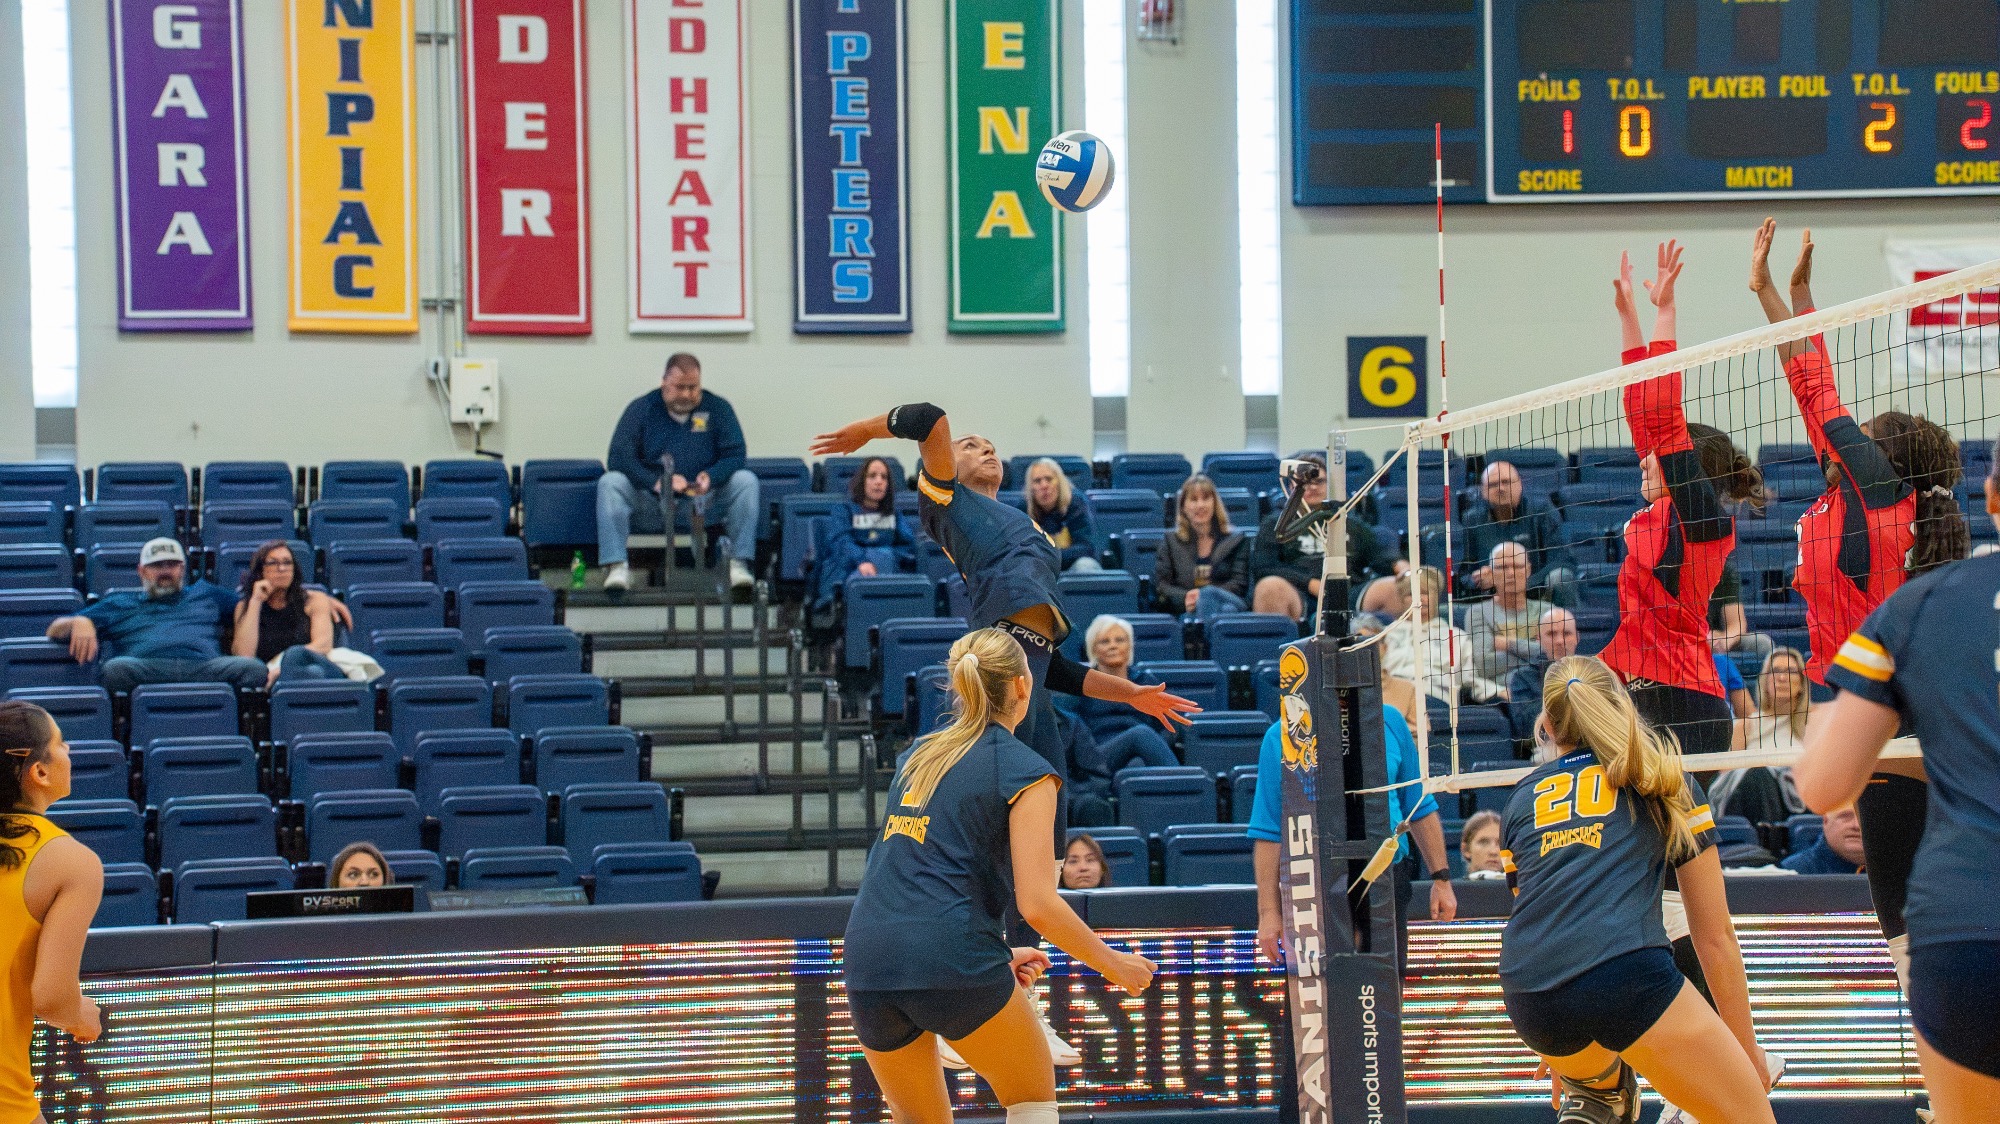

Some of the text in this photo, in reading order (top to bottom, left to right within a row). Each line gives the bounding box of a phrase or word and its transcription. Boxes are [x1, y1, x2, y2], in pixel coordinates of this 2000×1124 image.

[1518, 78, 1582, 101] FOULS
[1607, 78, 1665, 100] T.O.L.
[1688, 74, 1830, 99] PLAYER FOUL
[1852, 72, 1910, 96] T.O.L.
[1935, 71, 2000, 94] FOULS
[151, 5, 213, 255] GARA
[497, 15, 555, 237] DER
[976, 21, 1036, 239] ENA
[1562, 109, 1574, 153] 1
[1619, 105, 1651, 157] 0
[1864, 102, 1896, 152] 2
[1960, 99, 1992, 150] 2
[667, 77, 712, 298] HEART
[827, 30, 874, 303] PETERS
[1518, 169, 1583, 192] SCORE
[1726, 165, 1794, 188] MATCH
[1935, 160, 2000, 185] SCORE
[1358, 345, 1418, 408] 6
[1011, 625, 1047, 647] PRO
[1564, 753, 1592, 764] METRO
[1534, 764, 1618, 829] 20
[1358, 984, 1380, 1049] sports
